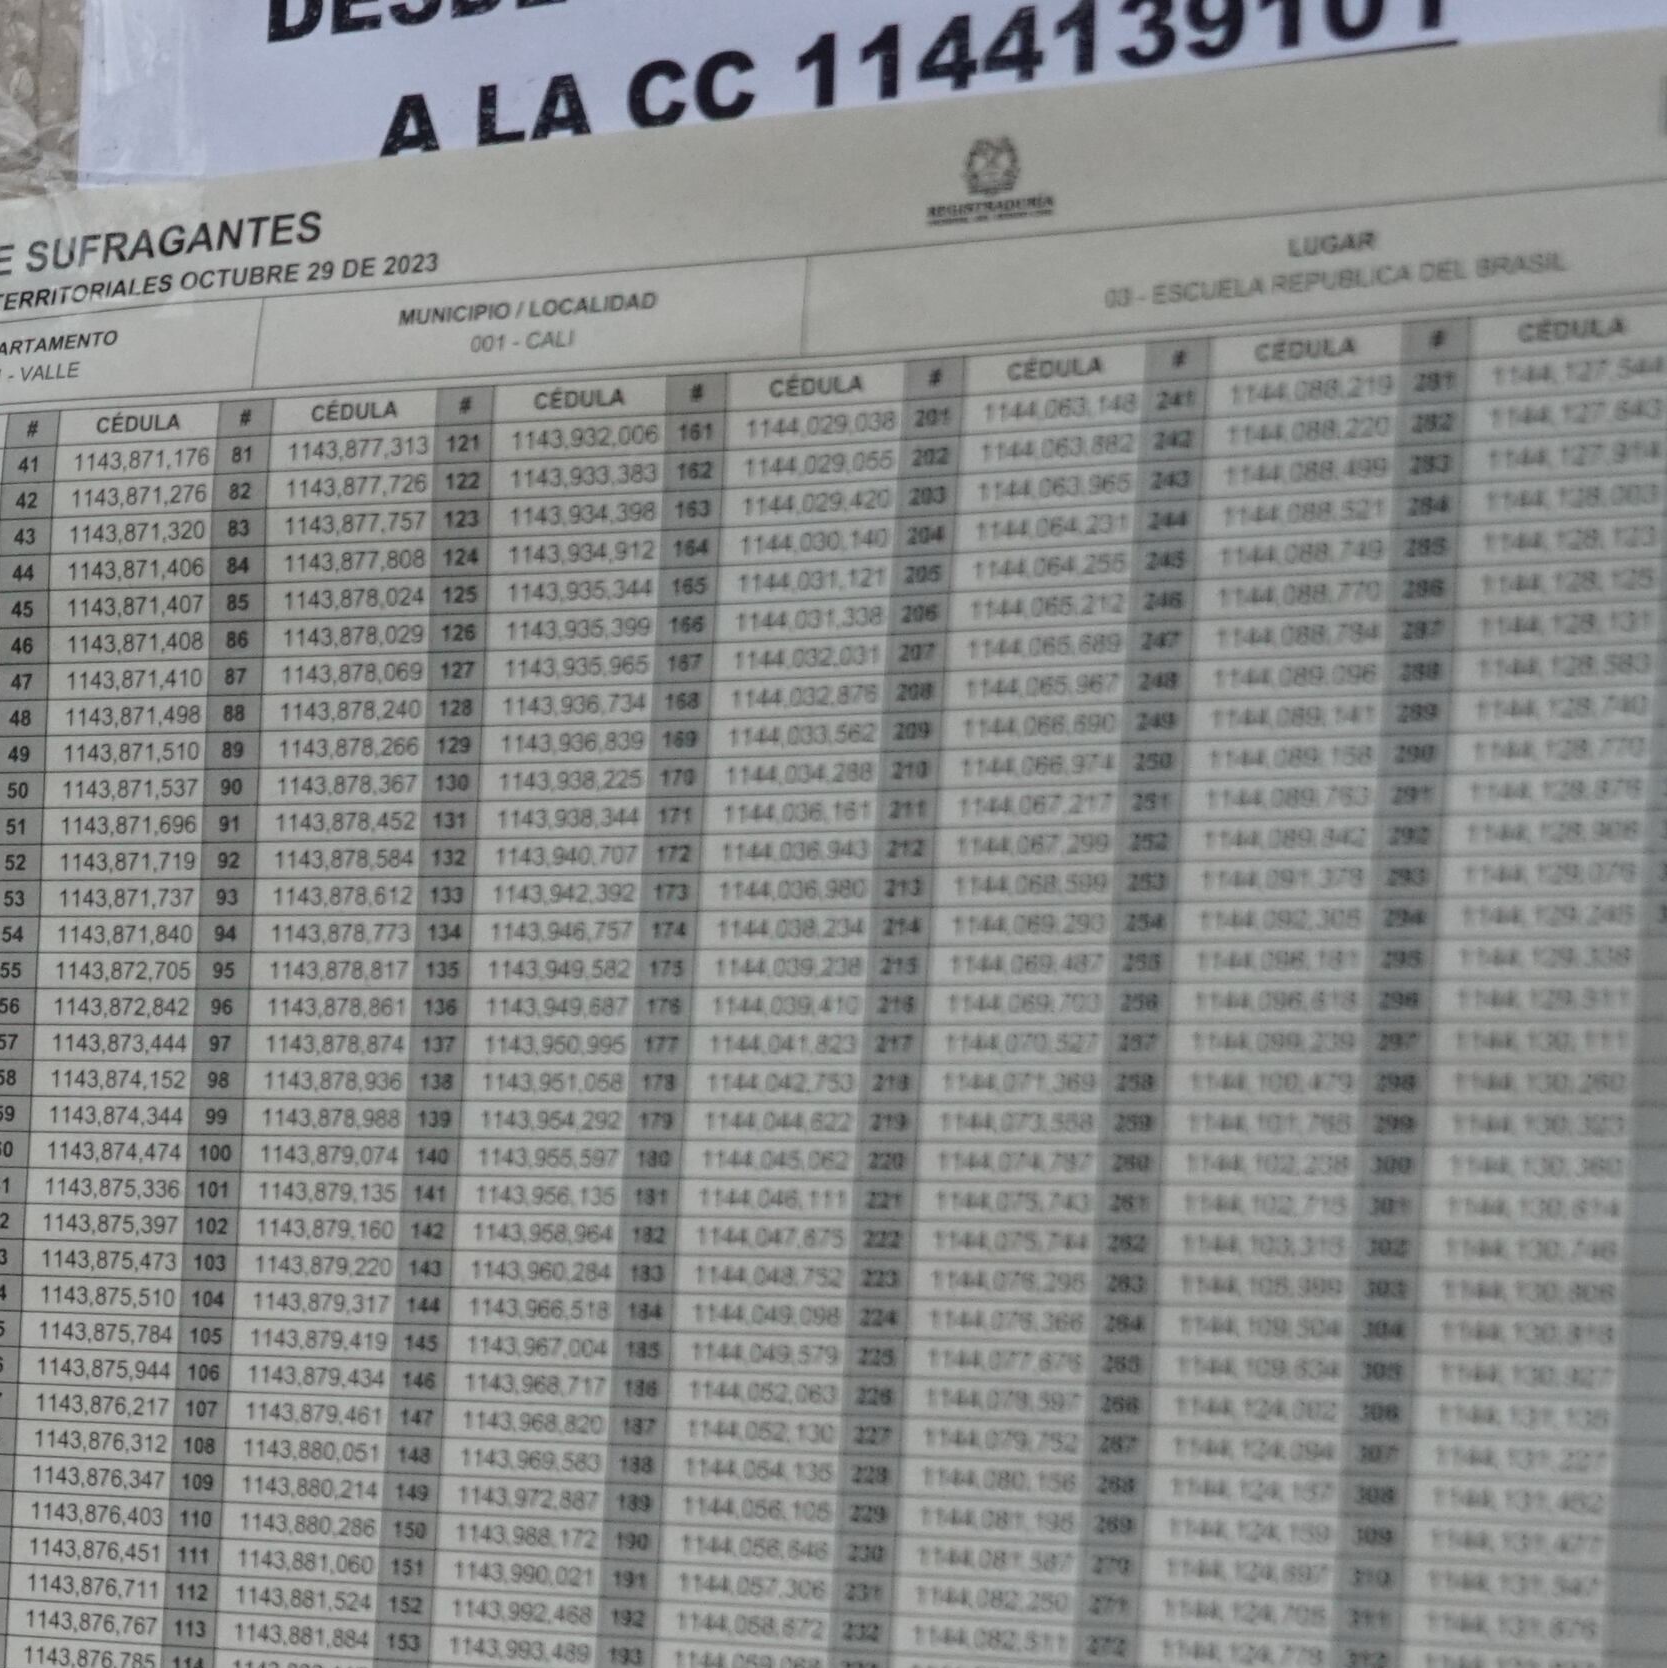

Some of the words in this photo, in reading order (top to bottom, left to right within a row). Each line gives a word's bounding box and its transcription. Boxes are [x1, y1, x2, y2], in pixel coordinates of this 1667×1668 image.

[380, 94, 439, 157] A
[478, 74, 591, 146] LA
[628, 51, 755, 128] CC
[26, 210, 322, 274] SUFRAGANTES
[180, 263, 299, 291] OCTUBRE
[306, 260, 335, 283] 29
[342, 257, 376, 278] DE
[383, 252, 439, 276] 2023
